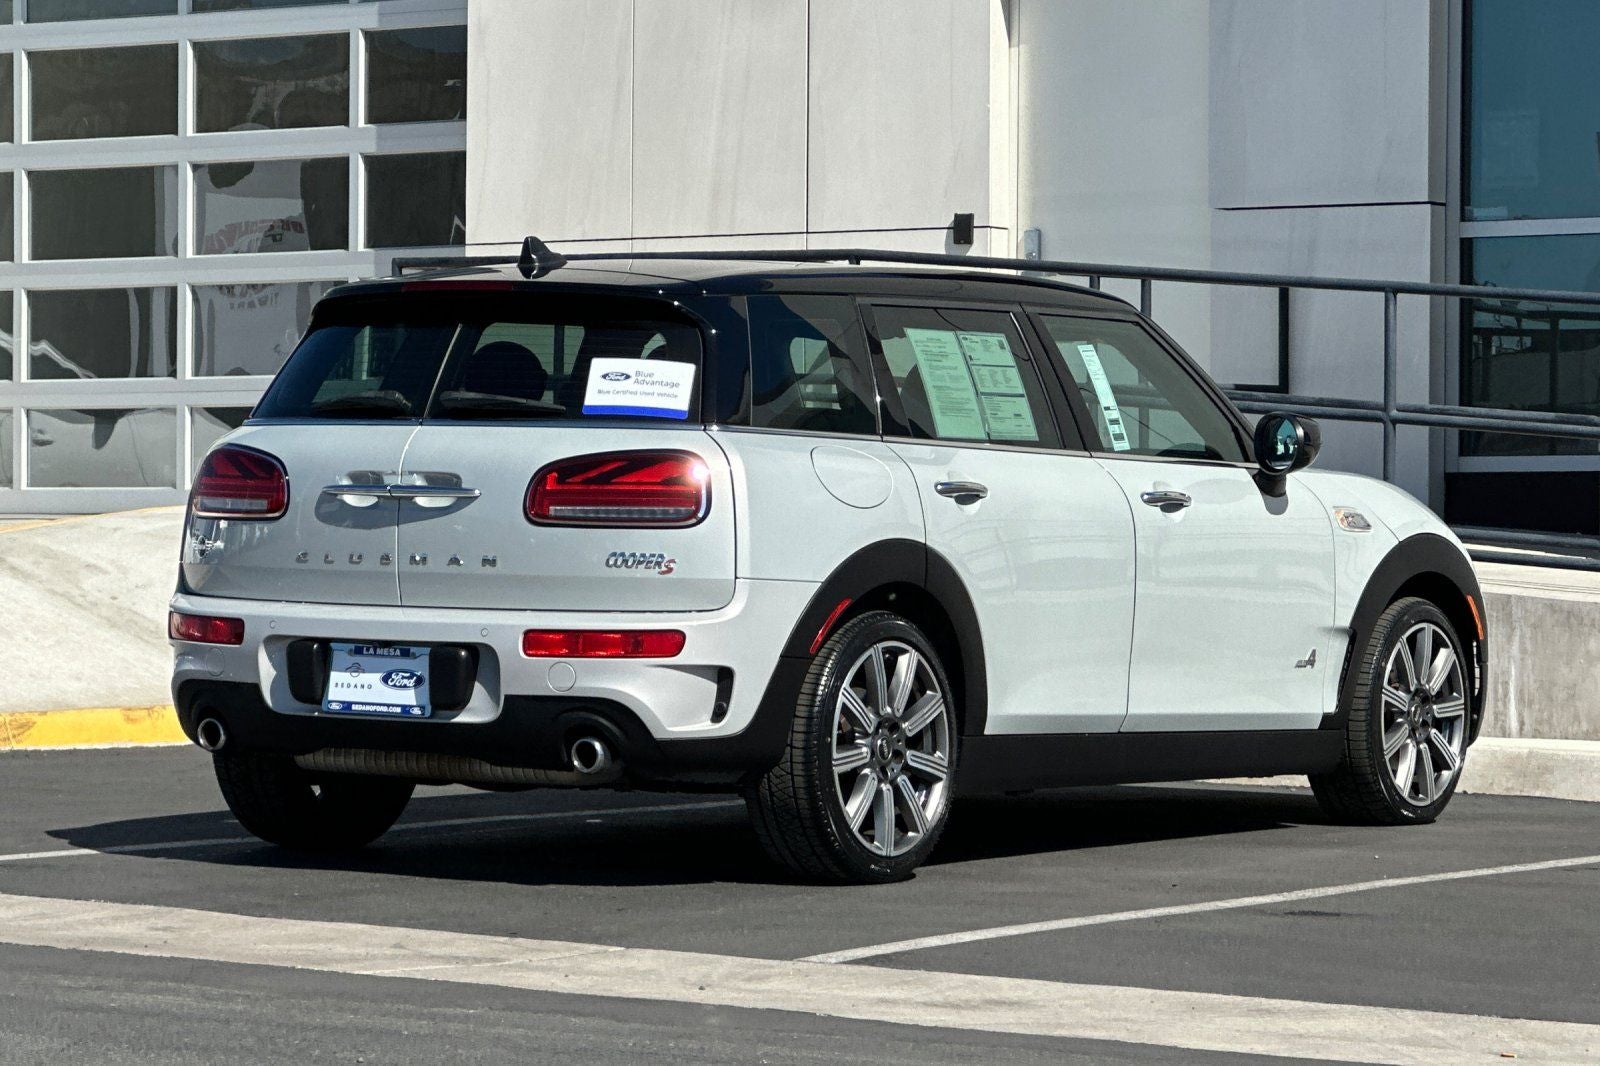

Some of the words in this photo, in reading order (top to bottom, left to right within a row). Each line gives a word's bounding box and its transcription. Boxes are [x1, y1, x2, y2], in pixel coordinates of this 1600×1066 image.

[635, 370, 655, 378] Blue
[633, 378, 680, 389] Advantage
[605, 551, 665, 570] COOPER
[657, 558, 677, 576] S
[363, 647, 374, 655] LA
[376, 648, 401, 656] MESA
[387, 671, 418, 687] Ford
[334, 682, 373, 690] SEDANO
